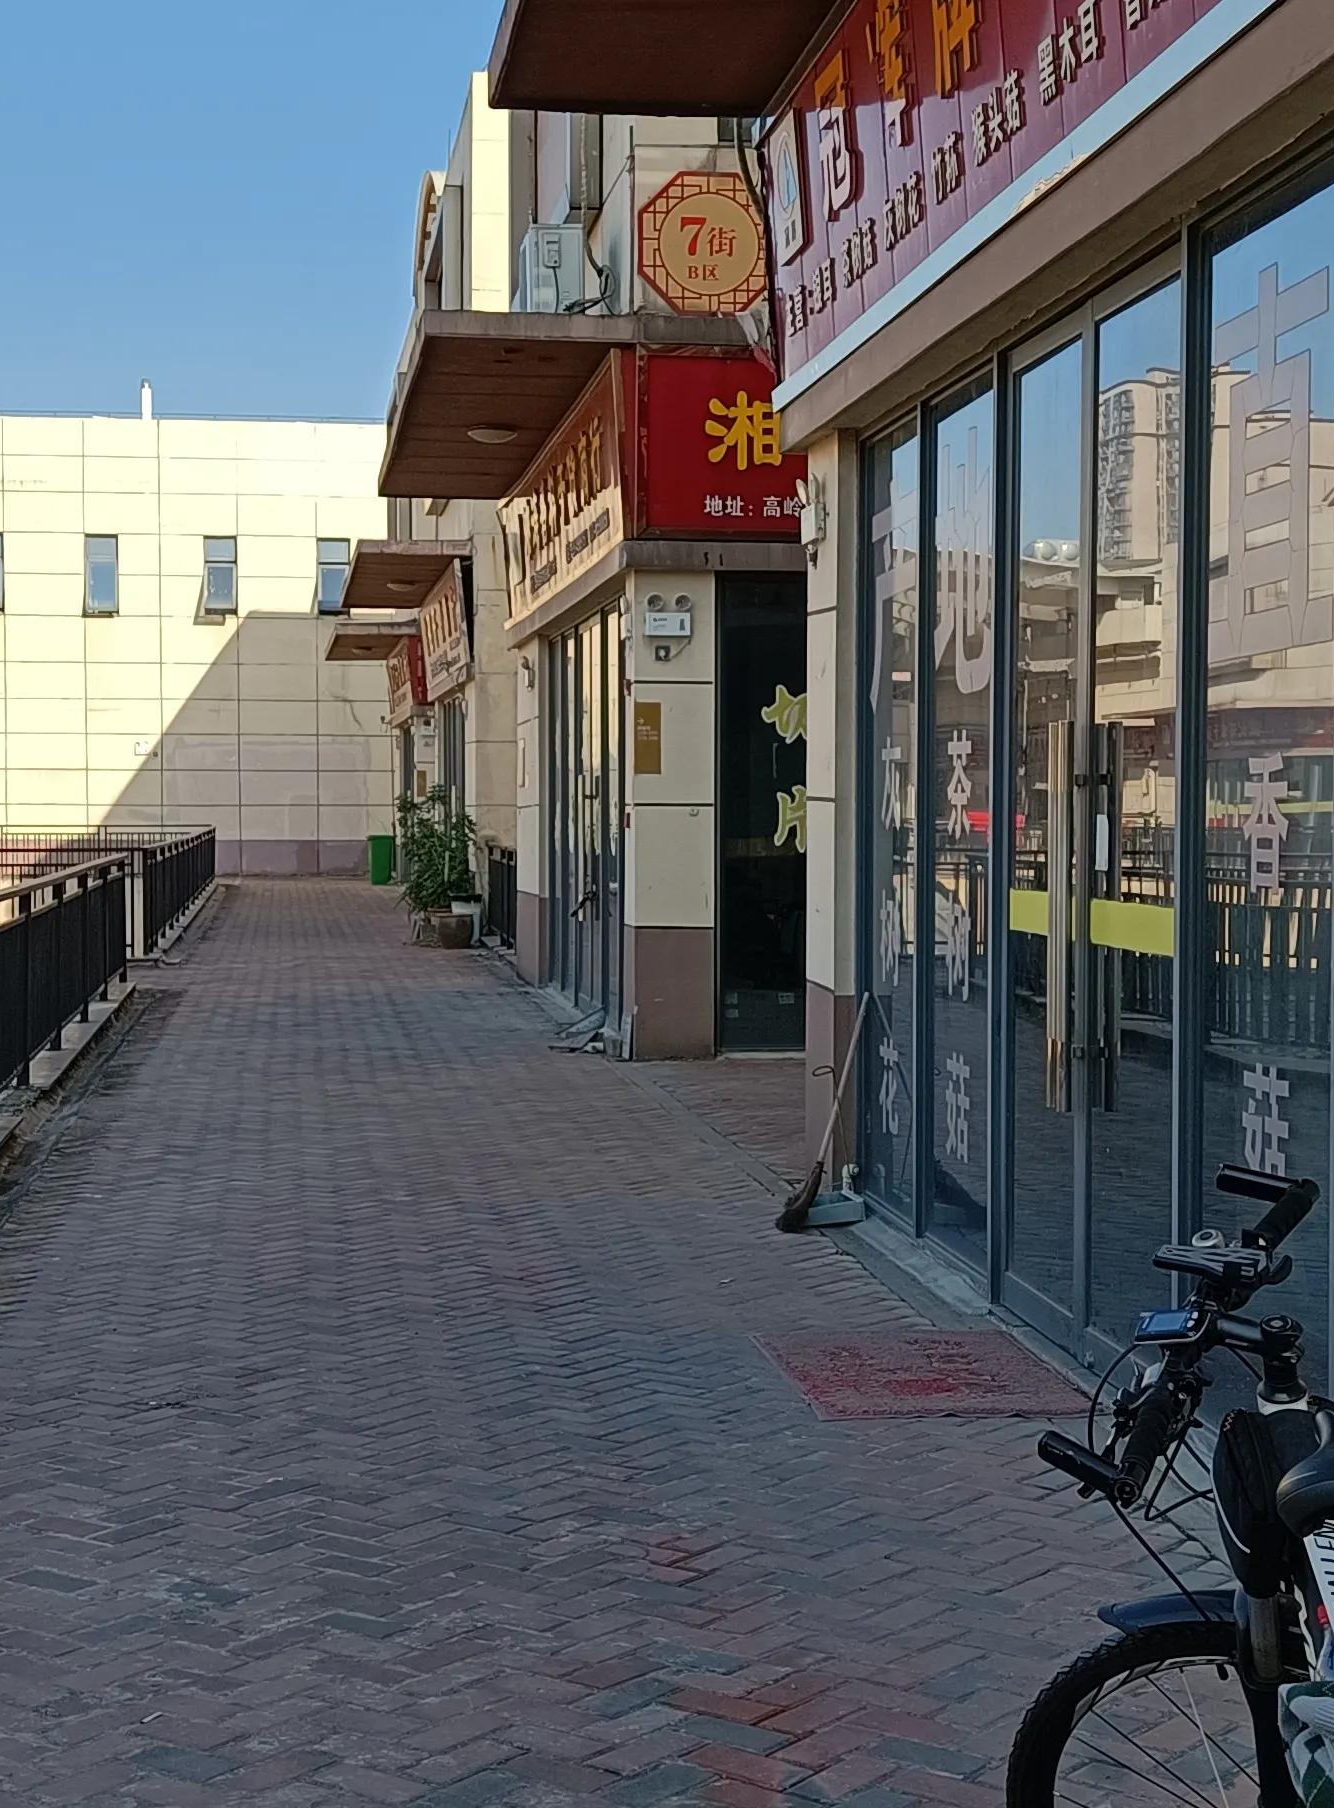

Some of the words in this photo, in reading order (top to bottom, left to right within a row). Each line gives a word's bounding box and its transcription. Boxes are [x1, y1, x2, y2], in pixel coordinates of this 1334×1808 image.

[680, 217, 737, 257] 7街
[883, 171, 923, 251] 灰树花
[971, 69, 1024, 166] 猴头菇
[1038, 0, 1101, 105] 黑木耳
[688, 264, 719, 281] B区
[705, 390, 782, 471] 湘
[879, 736, 902, 1135] 灰树花
[946, 729, 972, 1164] 茶树菇
[1242, 752, 1289, 1177] 香菇
